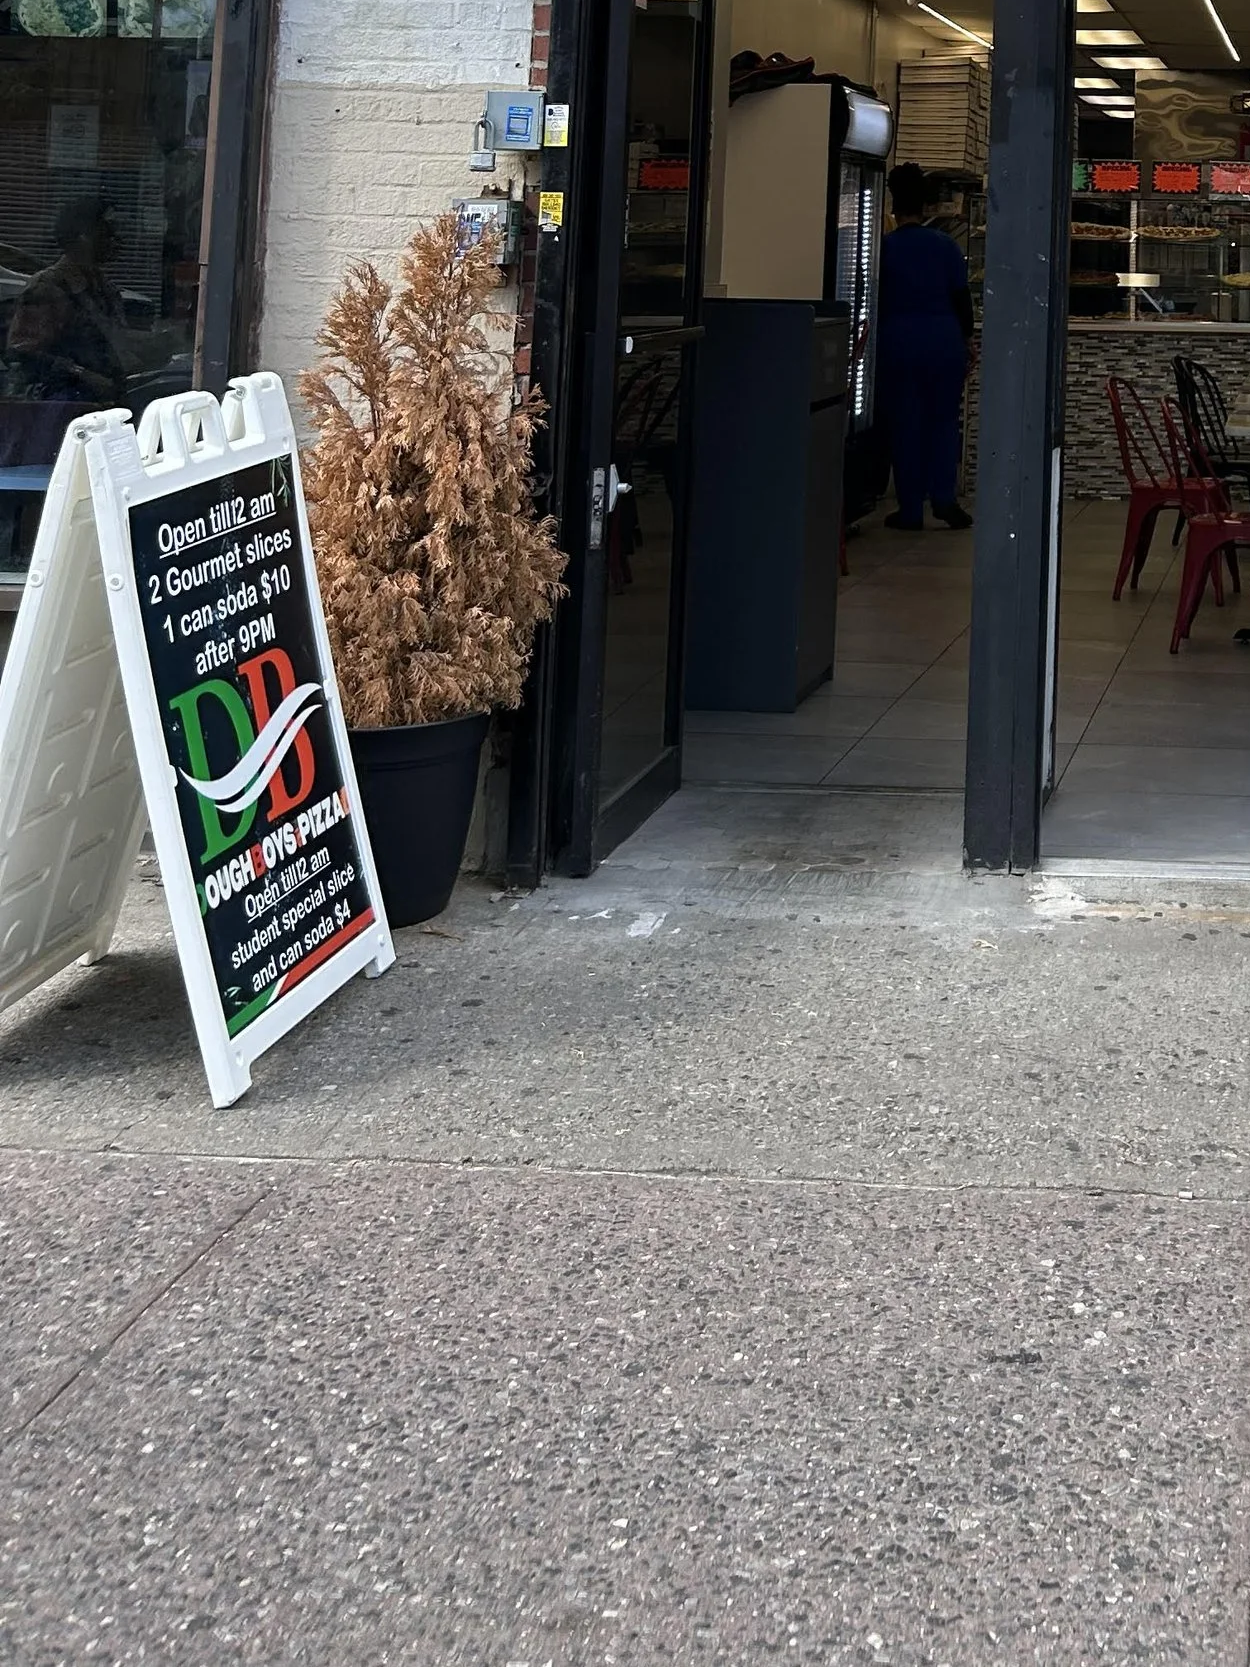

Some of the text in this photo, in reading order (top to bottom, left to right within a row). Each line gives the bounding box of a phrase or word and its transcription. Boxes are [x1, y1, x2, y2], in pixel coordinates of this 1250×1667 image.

[158, 517, 207, 556] Open
[250, 492, 275, 518] am
[149, 528, 292, 605] 2 Gourmet slices
[163, 564, 291, 644] 1 can soda $10
[195, 612, 277, 675] after 9PM
[297, 790, 346, 847] PIZZA
[231, 864, 356, 970] student special slice
[244, 881, 281, 918] Open
[310, 846, 331, 871] am
[252, 897, 352, 993] and can soda $4
